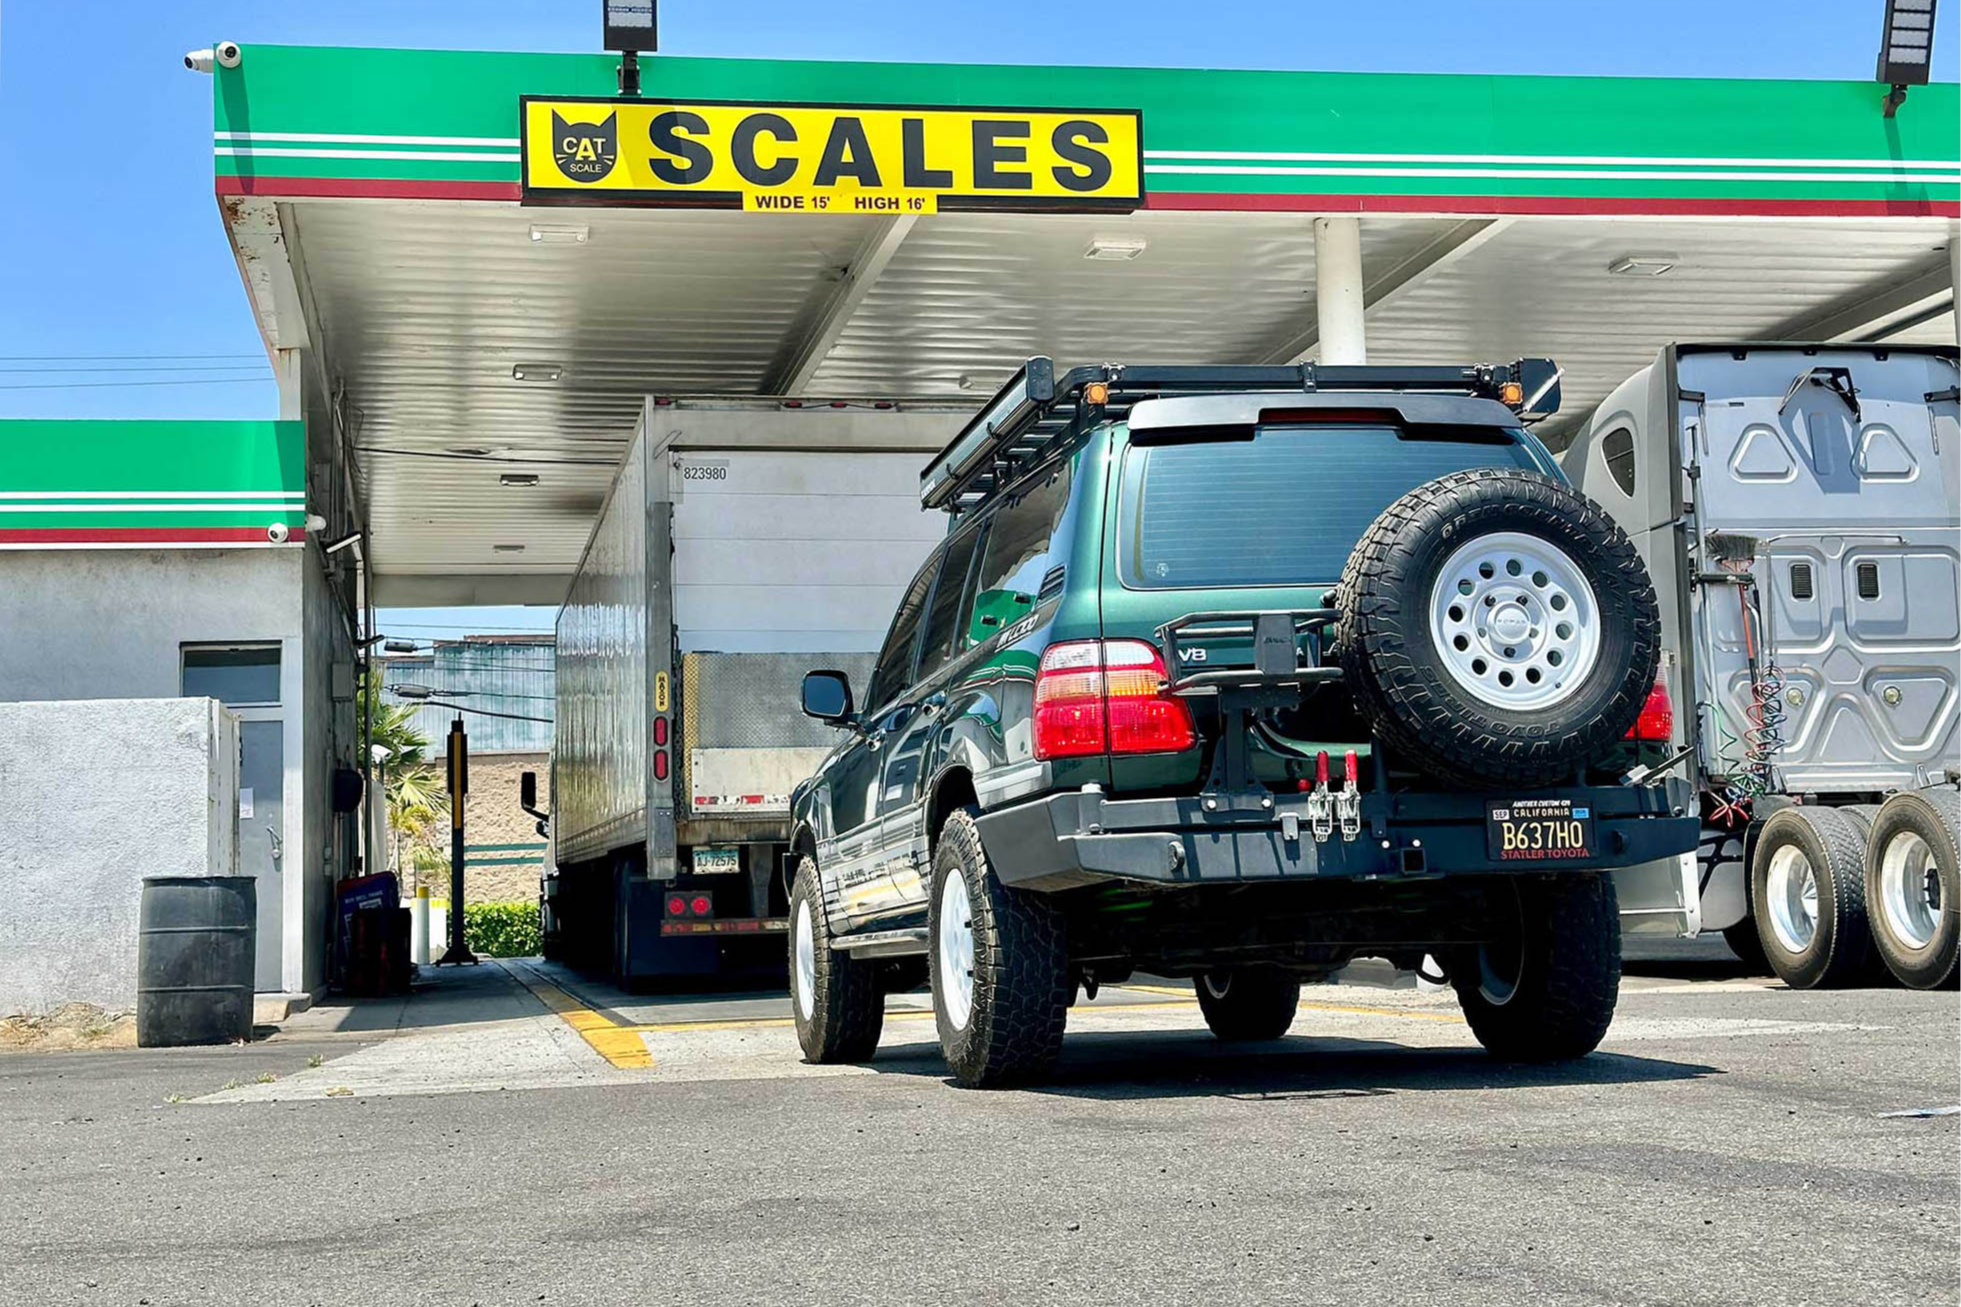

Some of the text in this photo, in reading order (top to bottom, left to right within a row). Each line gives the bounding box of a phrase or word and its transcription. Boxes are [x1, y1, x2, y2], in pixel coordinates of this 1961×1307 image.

[562, 136, 607, 161] CAT
[648, 110, 1113, 192] SCALES
[569, 163, 602, 173] SCALE
[755, 195, 926, 210] WIDE 15' HIGH 16'
[684, 467, 727, 480] 823980
[1440, 503, 1499, 540] OPEN
[1178, 647, 1207, 662] V8
[1494, 810, 1508, 819] SEP
[1513, 808, 1571, 818] CALIFORNIA
[1501, 848, 1590, 860] STATLER TOYOTA
